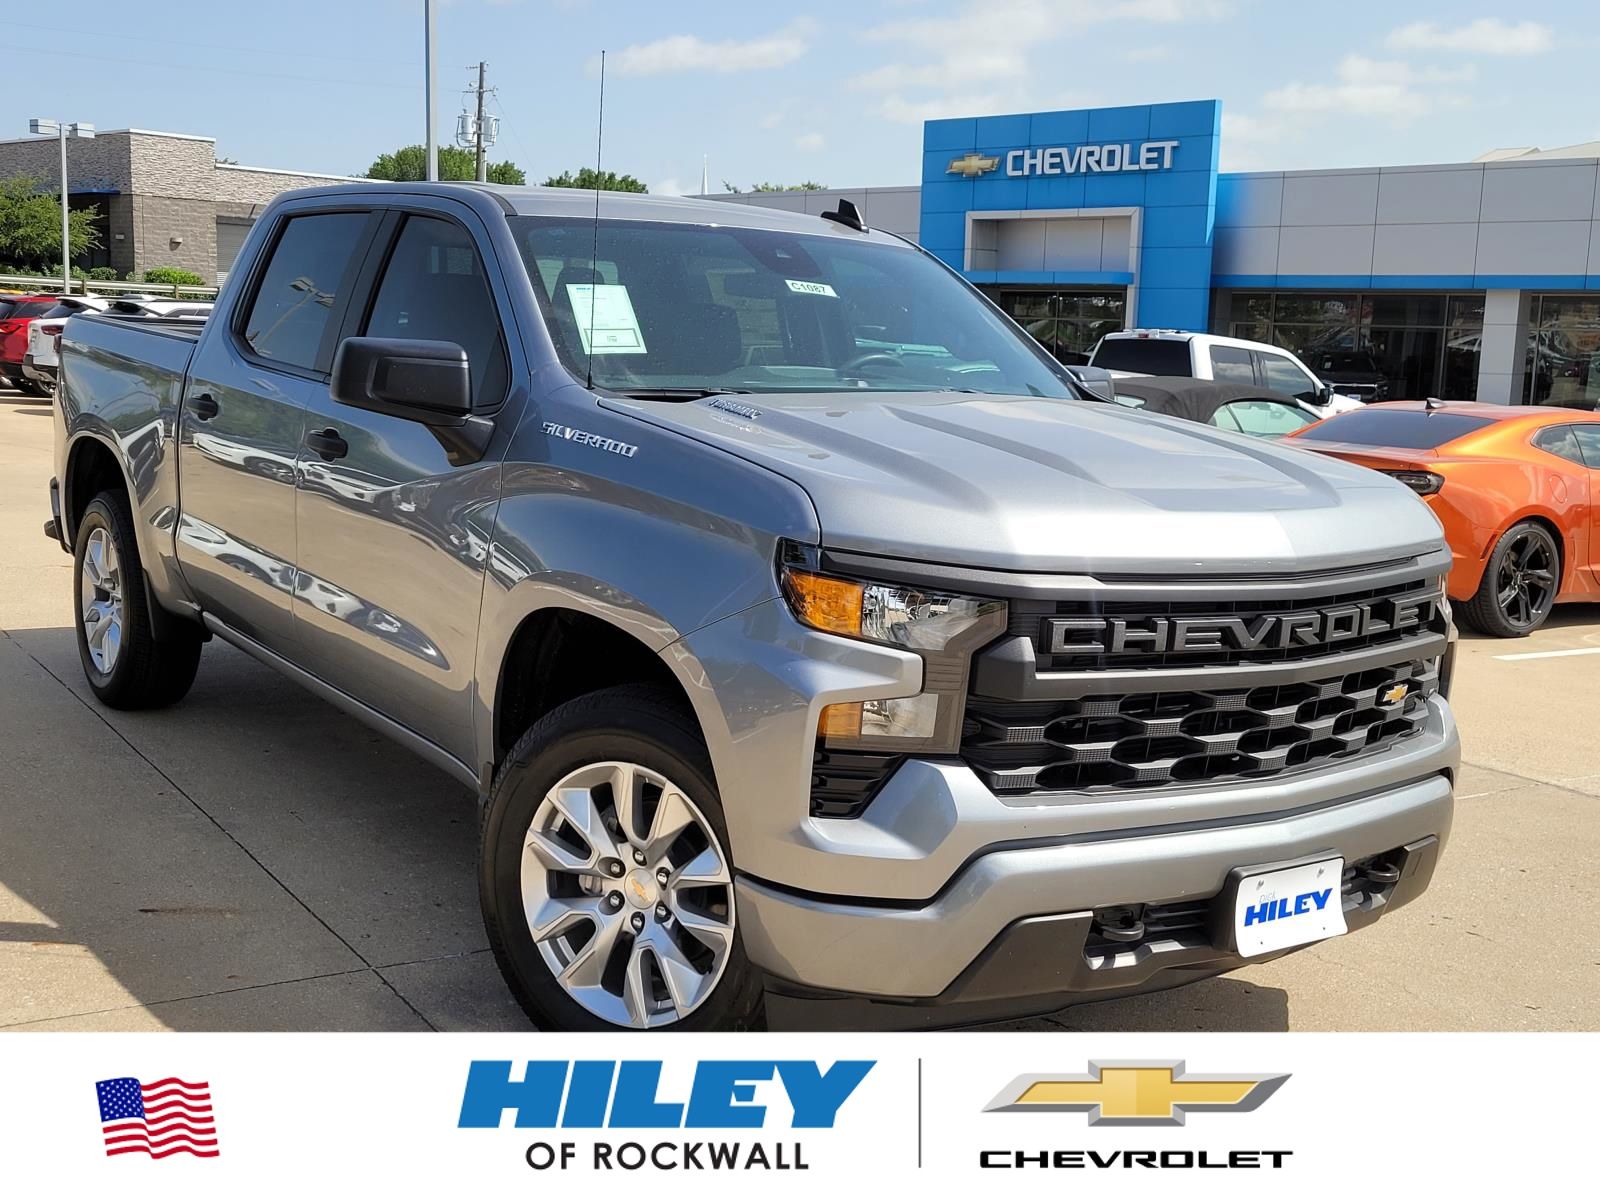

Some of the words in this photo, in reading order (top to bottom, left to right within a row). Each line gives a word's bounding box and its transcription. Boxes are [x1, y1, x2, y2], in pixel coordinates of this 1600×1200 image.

[1006, 140, 1181, 177] CHEVROLET
[540, 421, 638, 458] SILVERADO
[1048, 591, 1443, 653] CHEVROLET
[1243, 887, 1334, 927] HILEY
